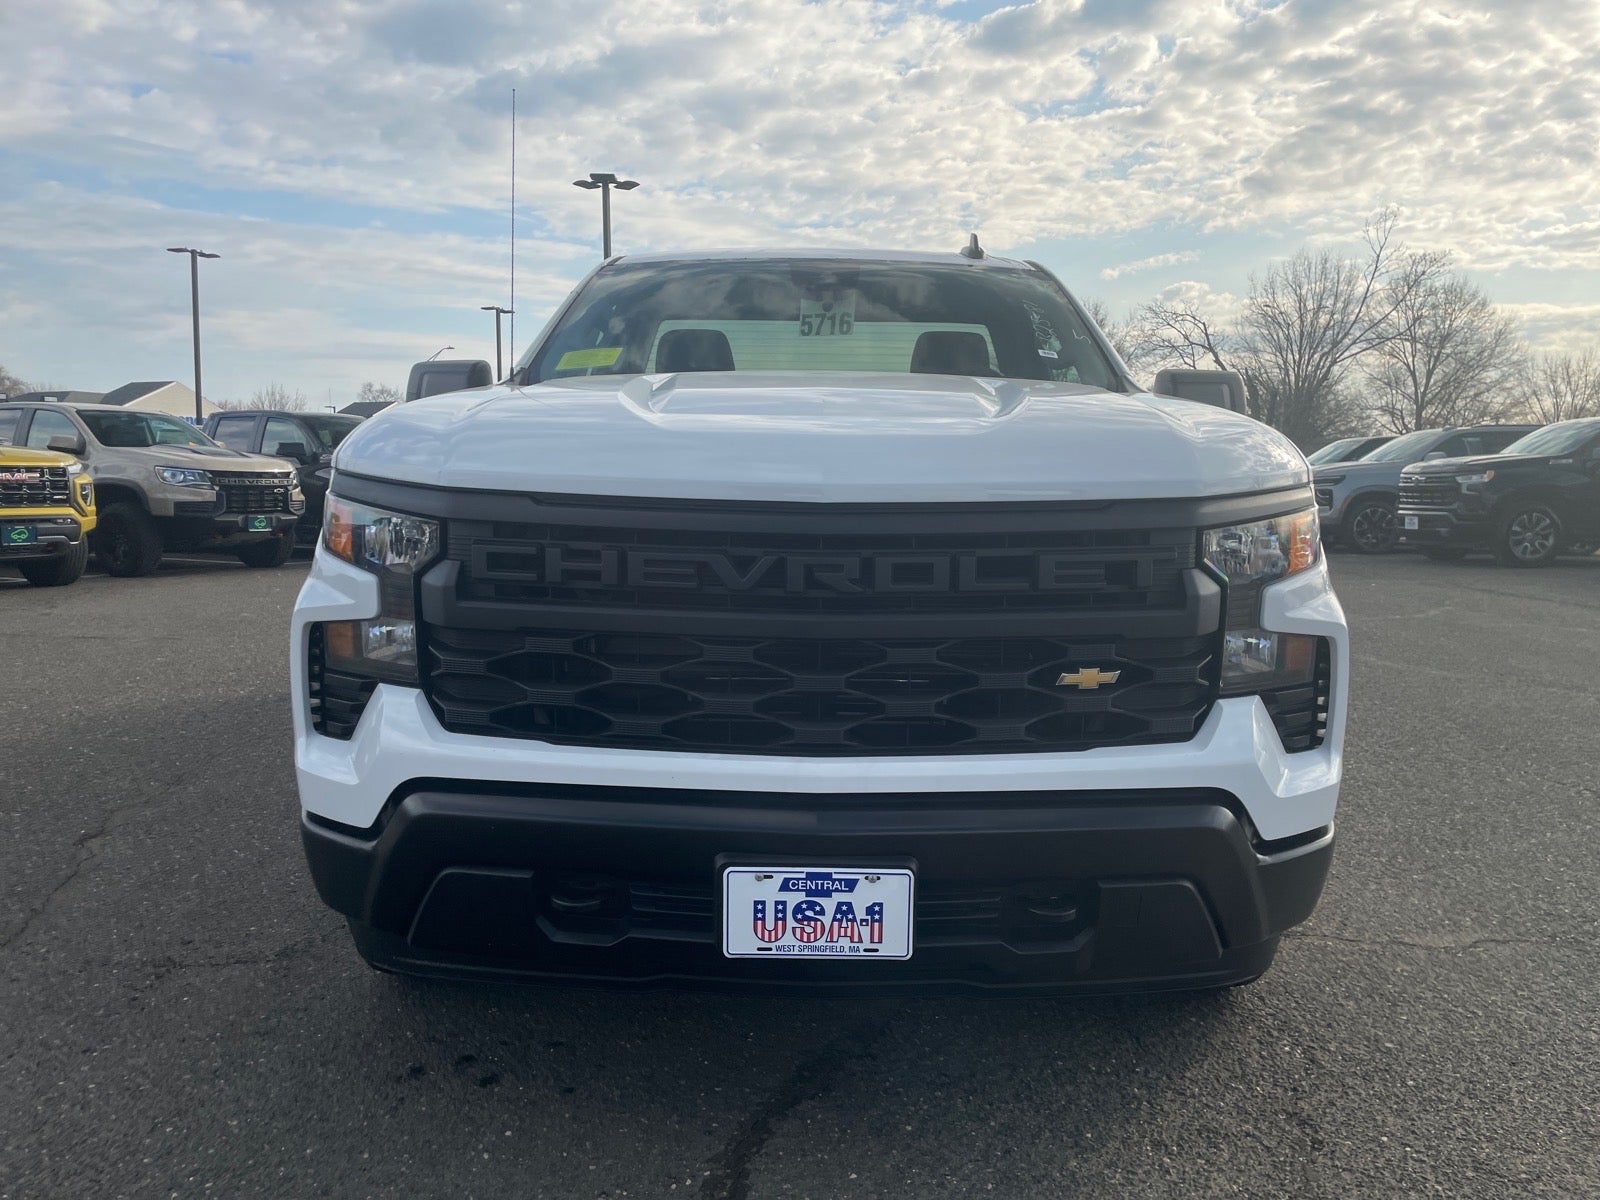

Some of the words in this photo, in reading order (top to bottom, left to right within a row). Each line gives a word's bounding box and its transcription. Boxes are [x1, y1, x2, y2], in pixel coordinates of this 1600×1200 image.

[800, 312, 853, 337] 5716
[0, 472, 40, 483] MC
[216, 477, 293, 486] CHEVROLET
[470, 541, 1178, 593] CHEVROLET
[788, 880, 849, 891] CENTRAL
[775, 944, 797, 953] WEST
[798, 944, 847, 954] SPRINGFIELD,
